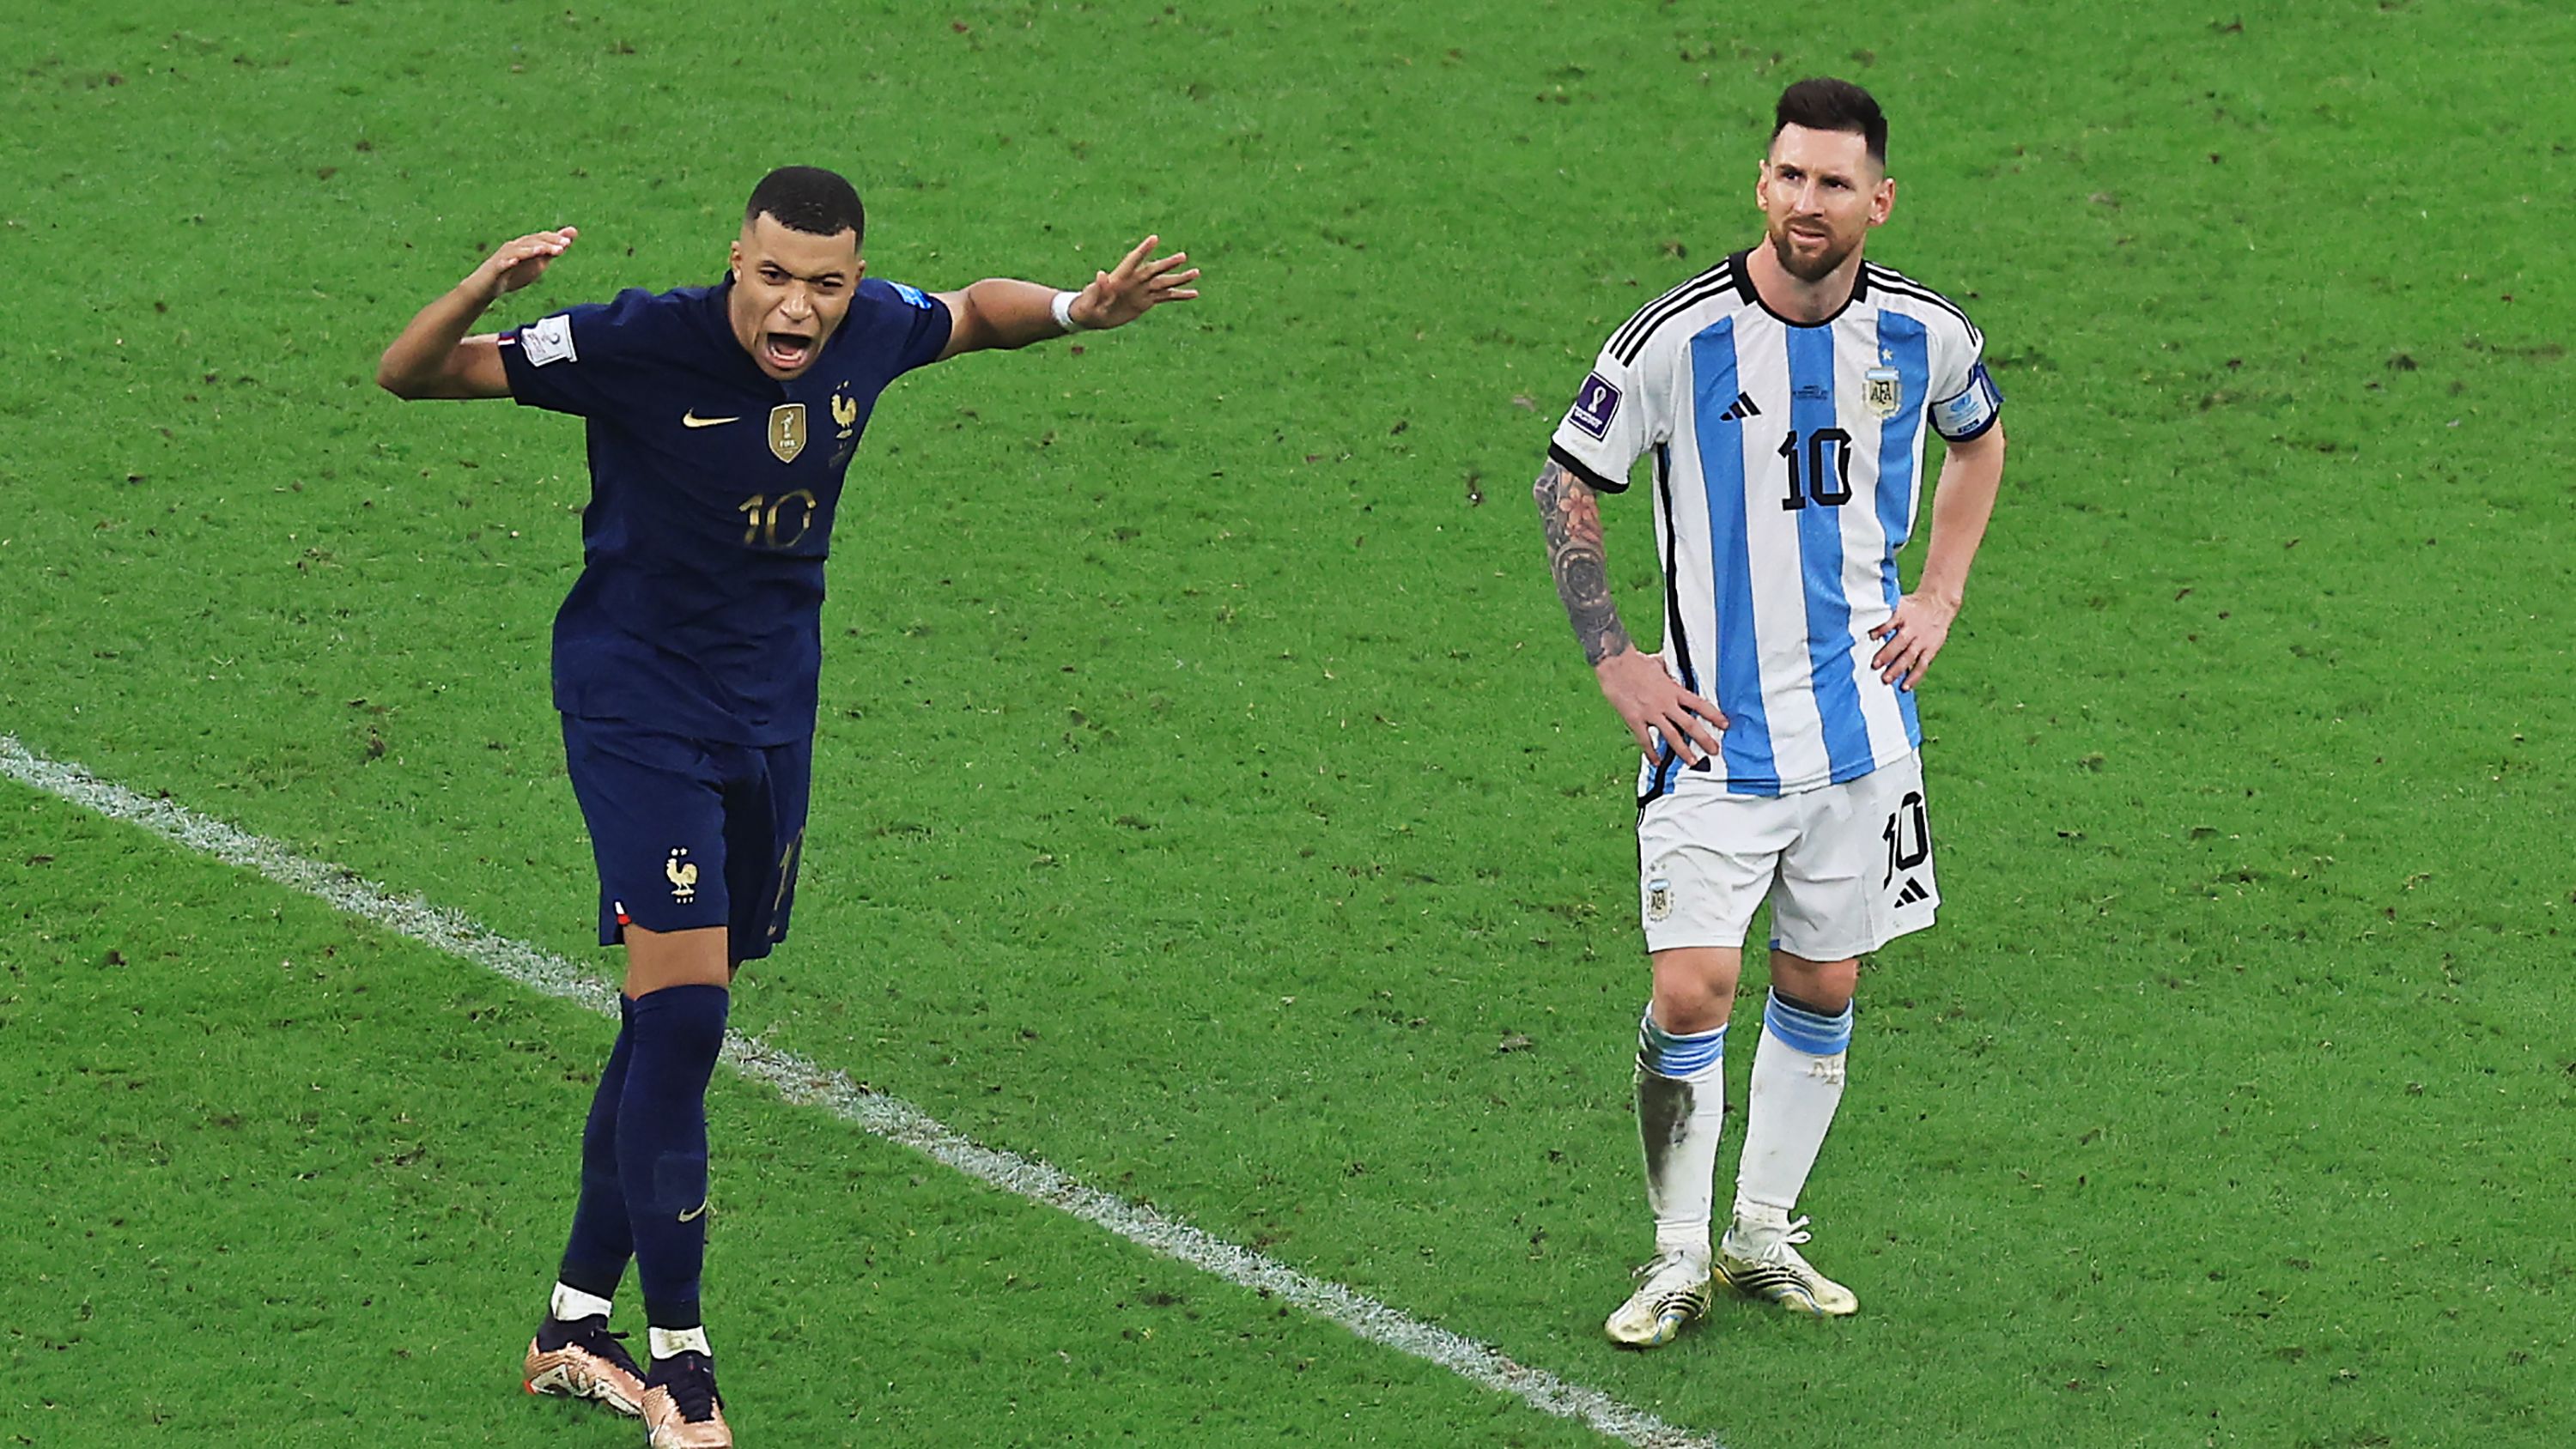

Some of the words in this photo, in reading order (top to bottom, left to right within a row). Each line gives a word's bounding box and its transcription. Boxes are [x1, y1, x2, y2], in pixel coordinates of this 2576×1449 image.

[1870, 380, 1892, 404] AFA
[1777, 427, 1853, 512] 10
[738, 488, 817, 548] 10
[1882, 791, 1929, 891] 10
